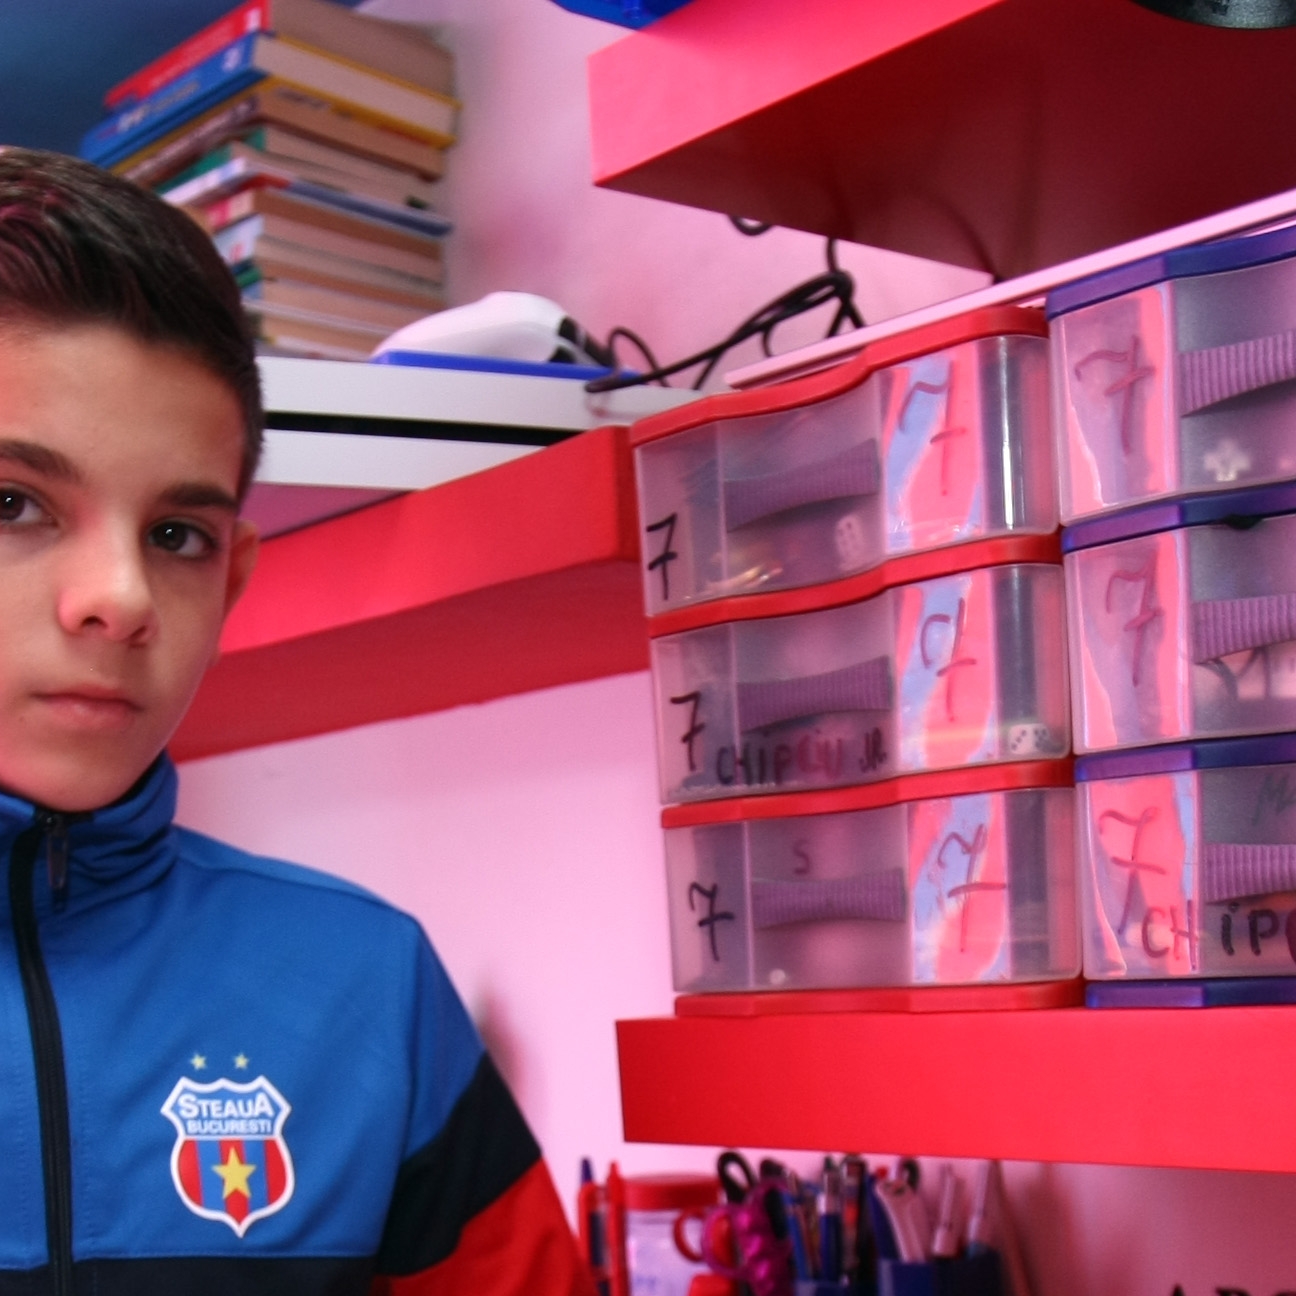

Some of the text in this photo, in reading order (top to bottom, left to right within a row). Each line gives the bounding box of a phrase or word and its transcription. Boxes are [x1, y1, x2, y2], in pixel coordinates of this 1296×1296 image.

[900, 374, 968, 497] 7
[1074, 335, 1156, 455] 7
[646, 513, 678, 600] 7
[1106, 549, 1163, 687] 7
[670, 691, 707, 771] 7
[688, 882, 735, 962] 7
[937, 824, 1007, 953] 7
[1099, 807, 1167, 934] 7
[177, 1092, 275, 1118] STEAUA
[186, 1119, 272, 1134] BUCURESTI
